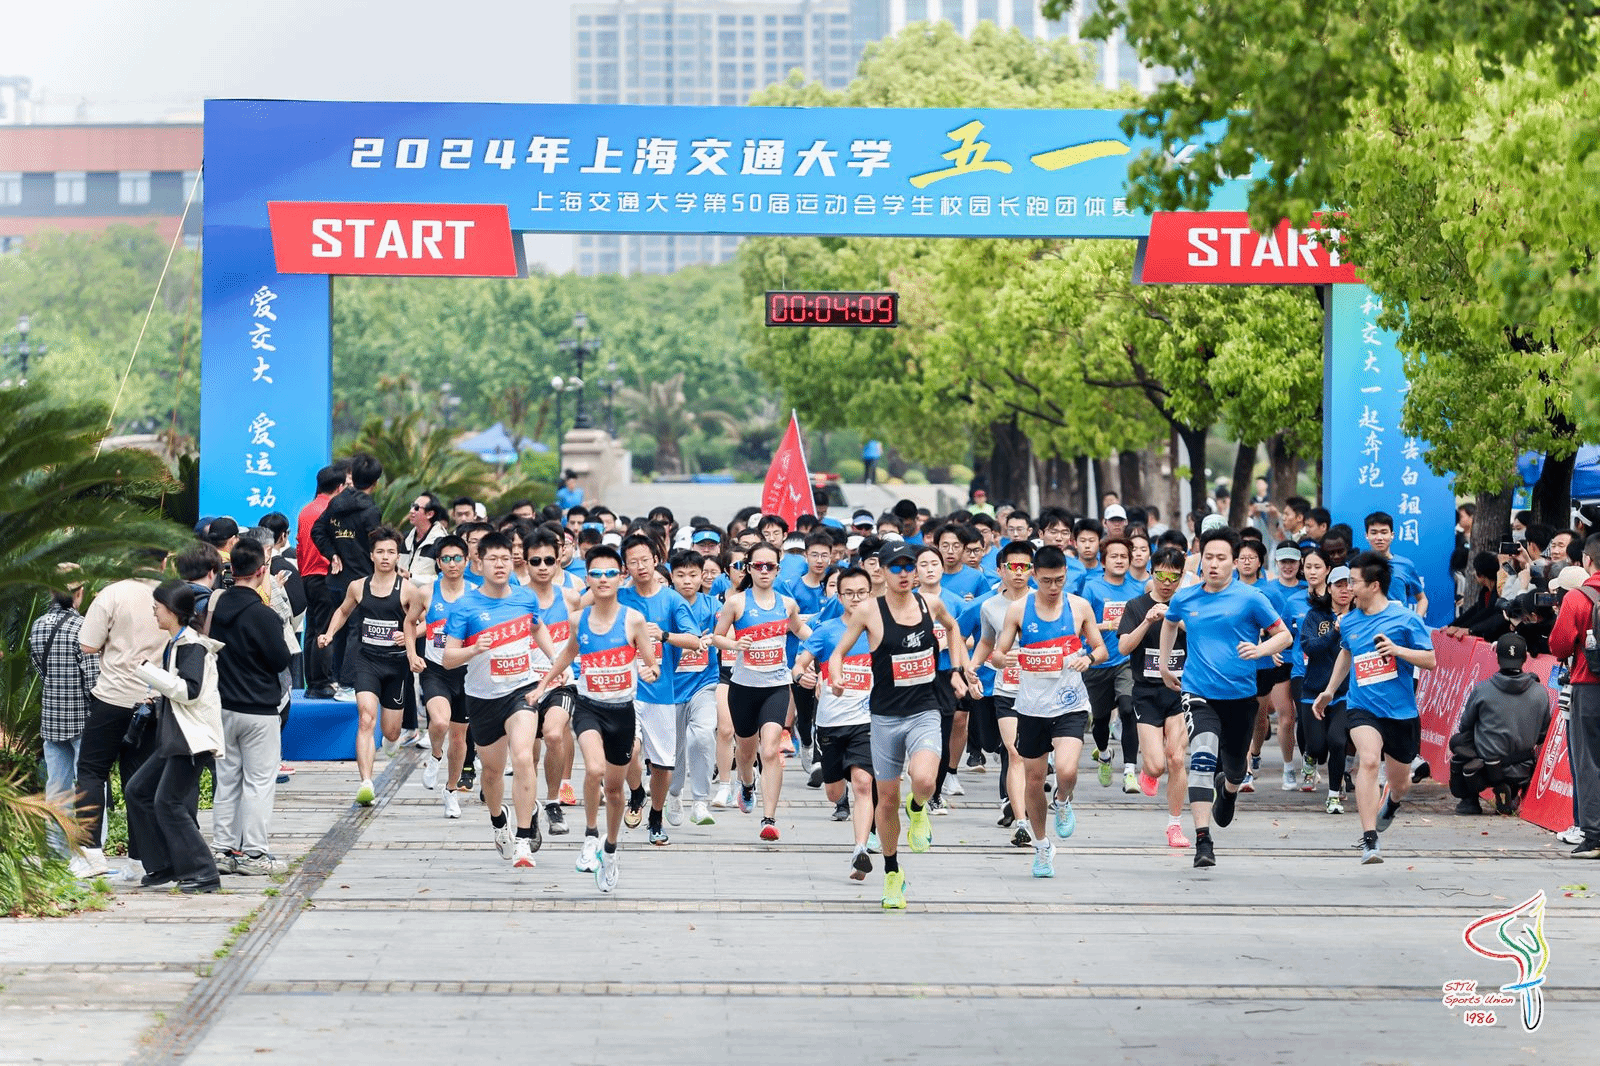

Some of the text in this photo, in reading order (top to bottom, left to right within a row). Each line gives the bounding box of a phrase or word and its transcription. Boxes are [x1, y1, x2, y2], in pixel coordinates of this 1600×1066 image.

[351, 136, 893, 178] 2024年上海交通大学
[909, 119, 1131, 190] 五一
[311, 218, 475, 260] START
[771, 294, 893, 323] 00:04:09
[245, 285, 279, 508] 爱交大 爱运动
[749, 650, 779, 660] S03-02
[1026, 655, 1057, 665] S09-02
[496, 656, 526, 669] S04-02
[900, 659, 932, 672] S03-03
[1358, 658, 1389, 673] S24-0
[591, 674, 627, 685] S03-01
[841, 672, 865, 683] 09-01
